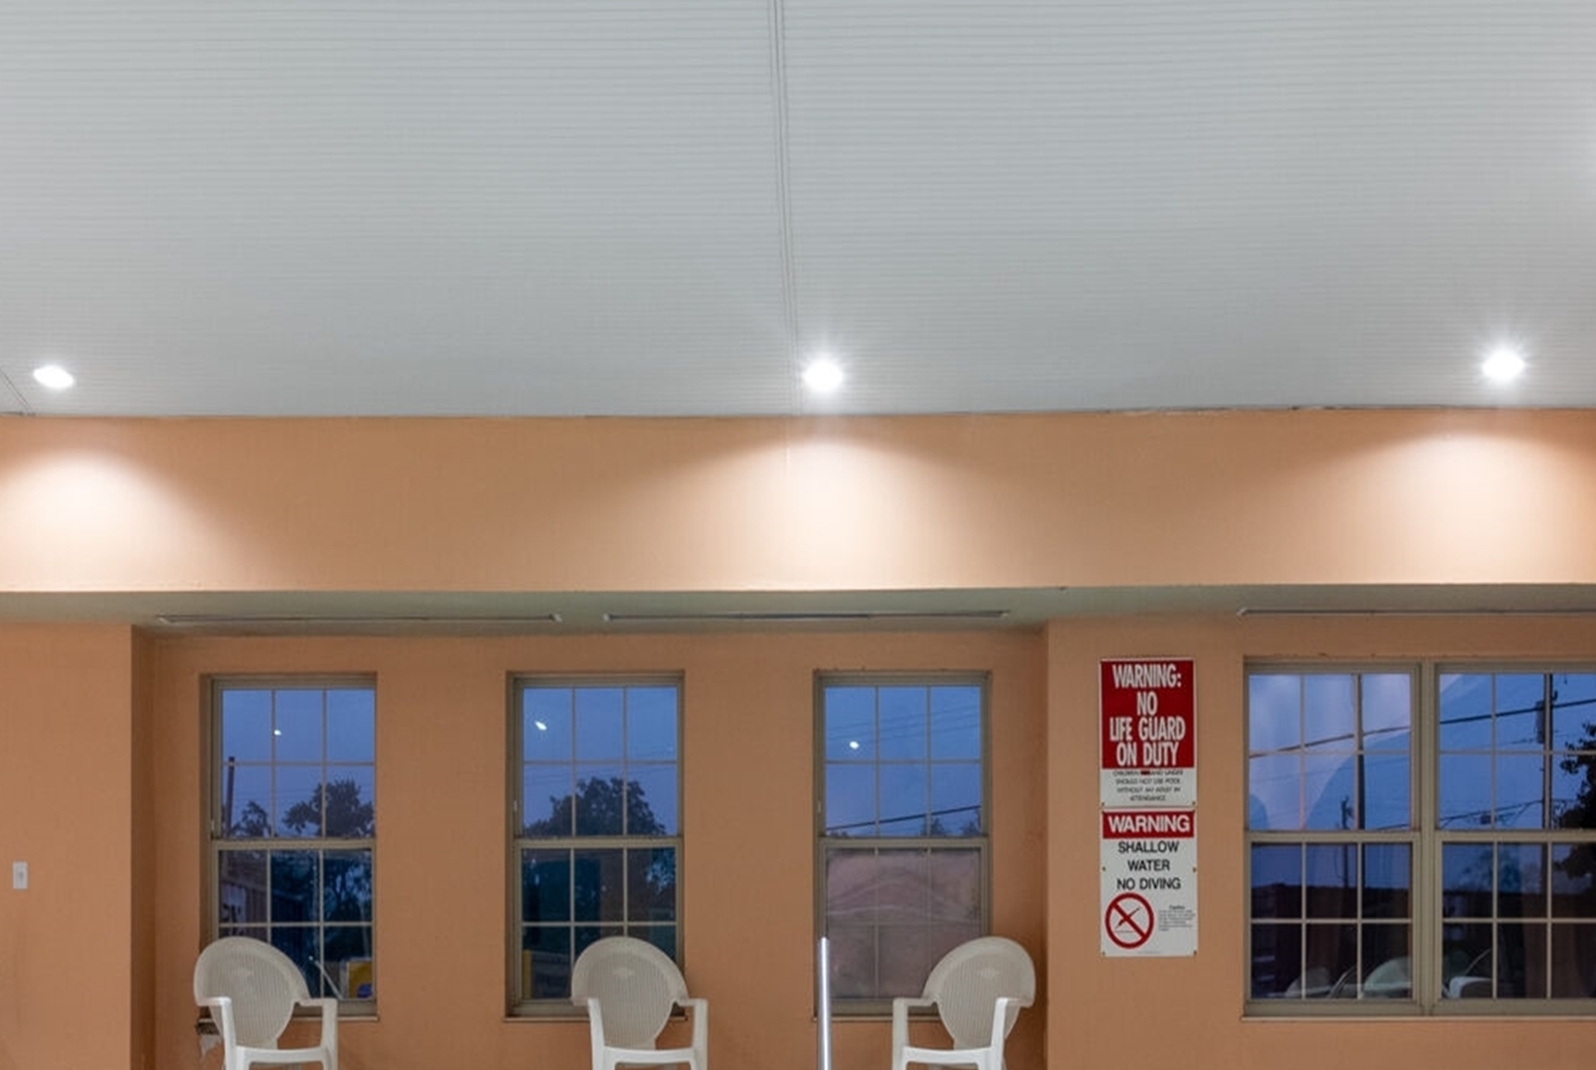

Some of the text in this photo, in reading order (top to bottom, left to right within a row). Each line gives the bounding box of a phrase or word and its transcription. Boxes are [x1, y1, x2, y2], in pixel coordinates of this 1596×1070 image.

[1112, 663, 1182, 689] WARNING:
[1136, 690, 1158, 716] NO
[1109, 715, 1186, 742] LIFE GUARD
[1116, 741, 1179, 767] ON DUTY
[1108, 814, 1190, 833] WARNING
[1118, 841, 1180, 854] SHALLOW
[1127, 859, 1171, 872] WATER
[1116, 877, 1182, 891] NO DIVING
